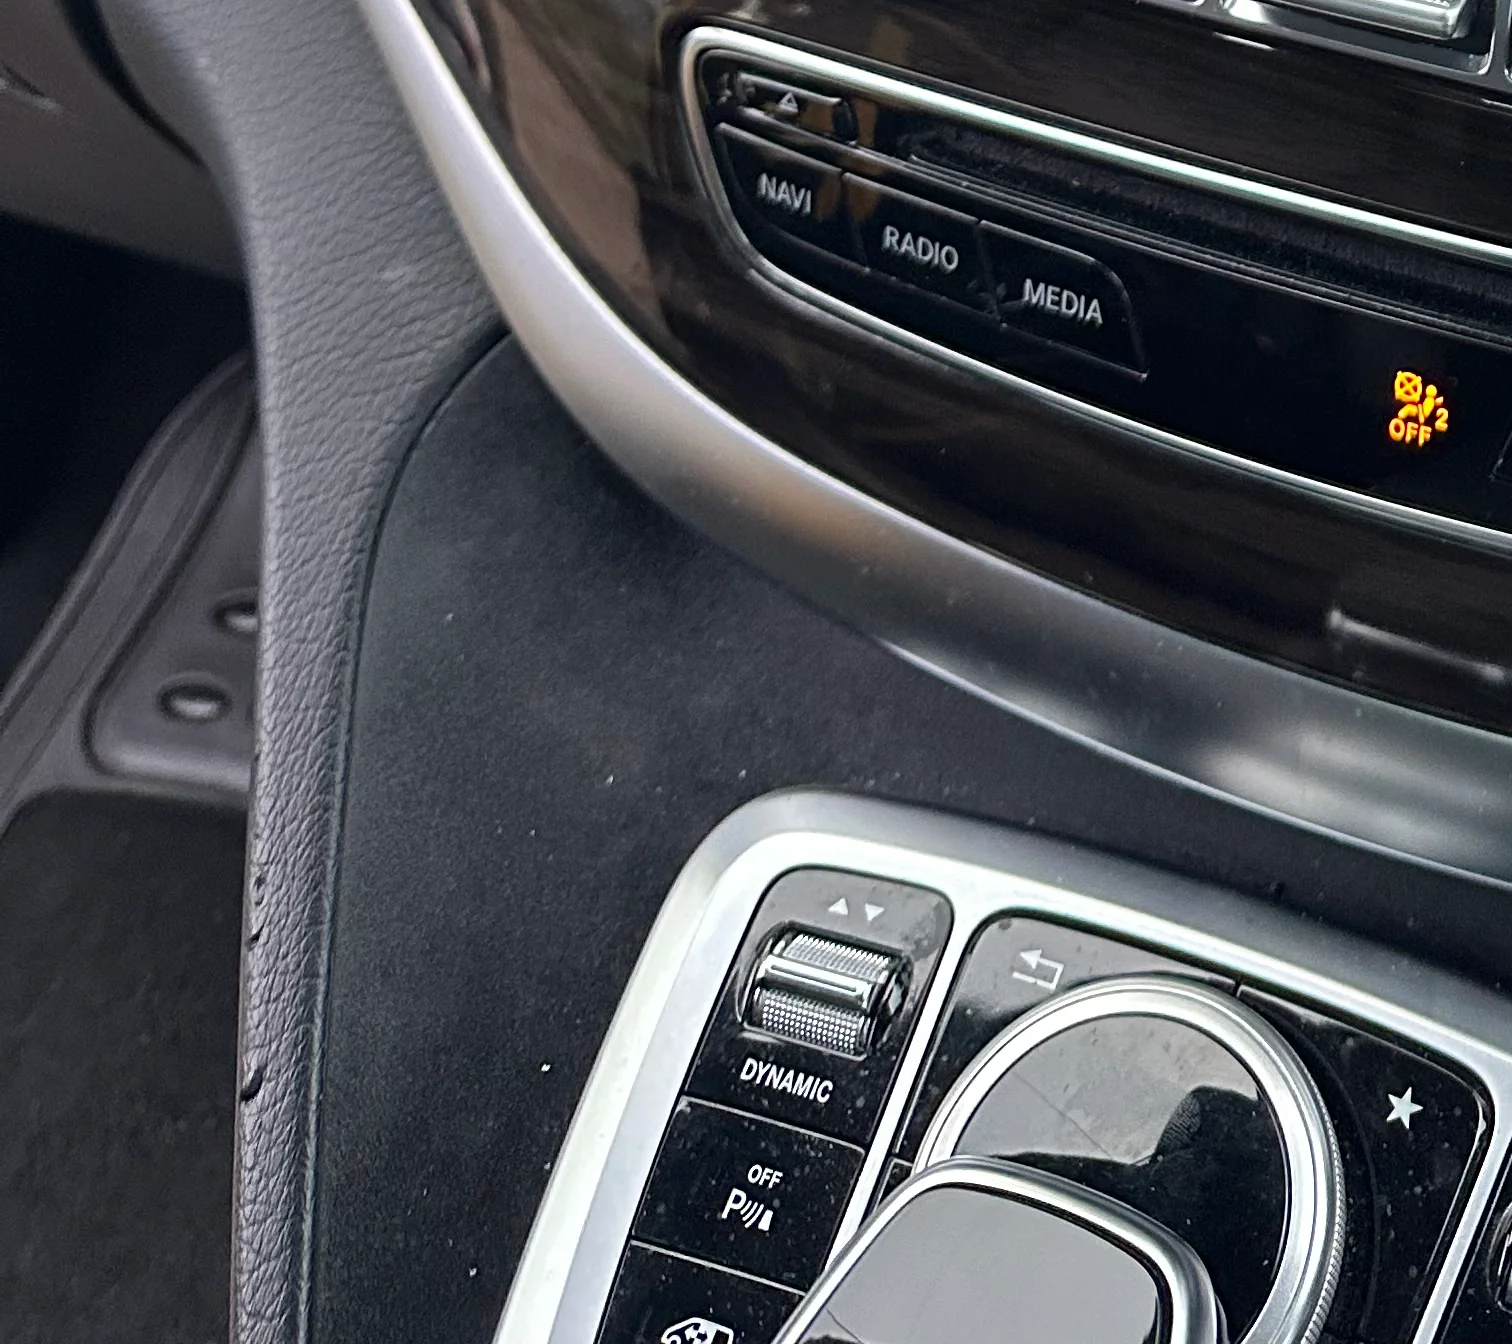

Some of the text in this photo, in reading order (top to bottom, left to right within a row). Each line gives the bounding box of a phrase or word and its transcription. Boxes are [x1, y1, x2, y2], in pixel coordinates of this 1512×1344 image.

[757, 171, 812, 213] NAVI
[881, 223, 960, 274] RADIO
[1022, 277, 1103, 325] MEDIA
[1388, 417, 1433, 447] OFF
[1434, 407, 1449, 431] 2
[739, 1057, 834, 1104] DYNAMIC
[746, 1164, 784, 1189] OFF
